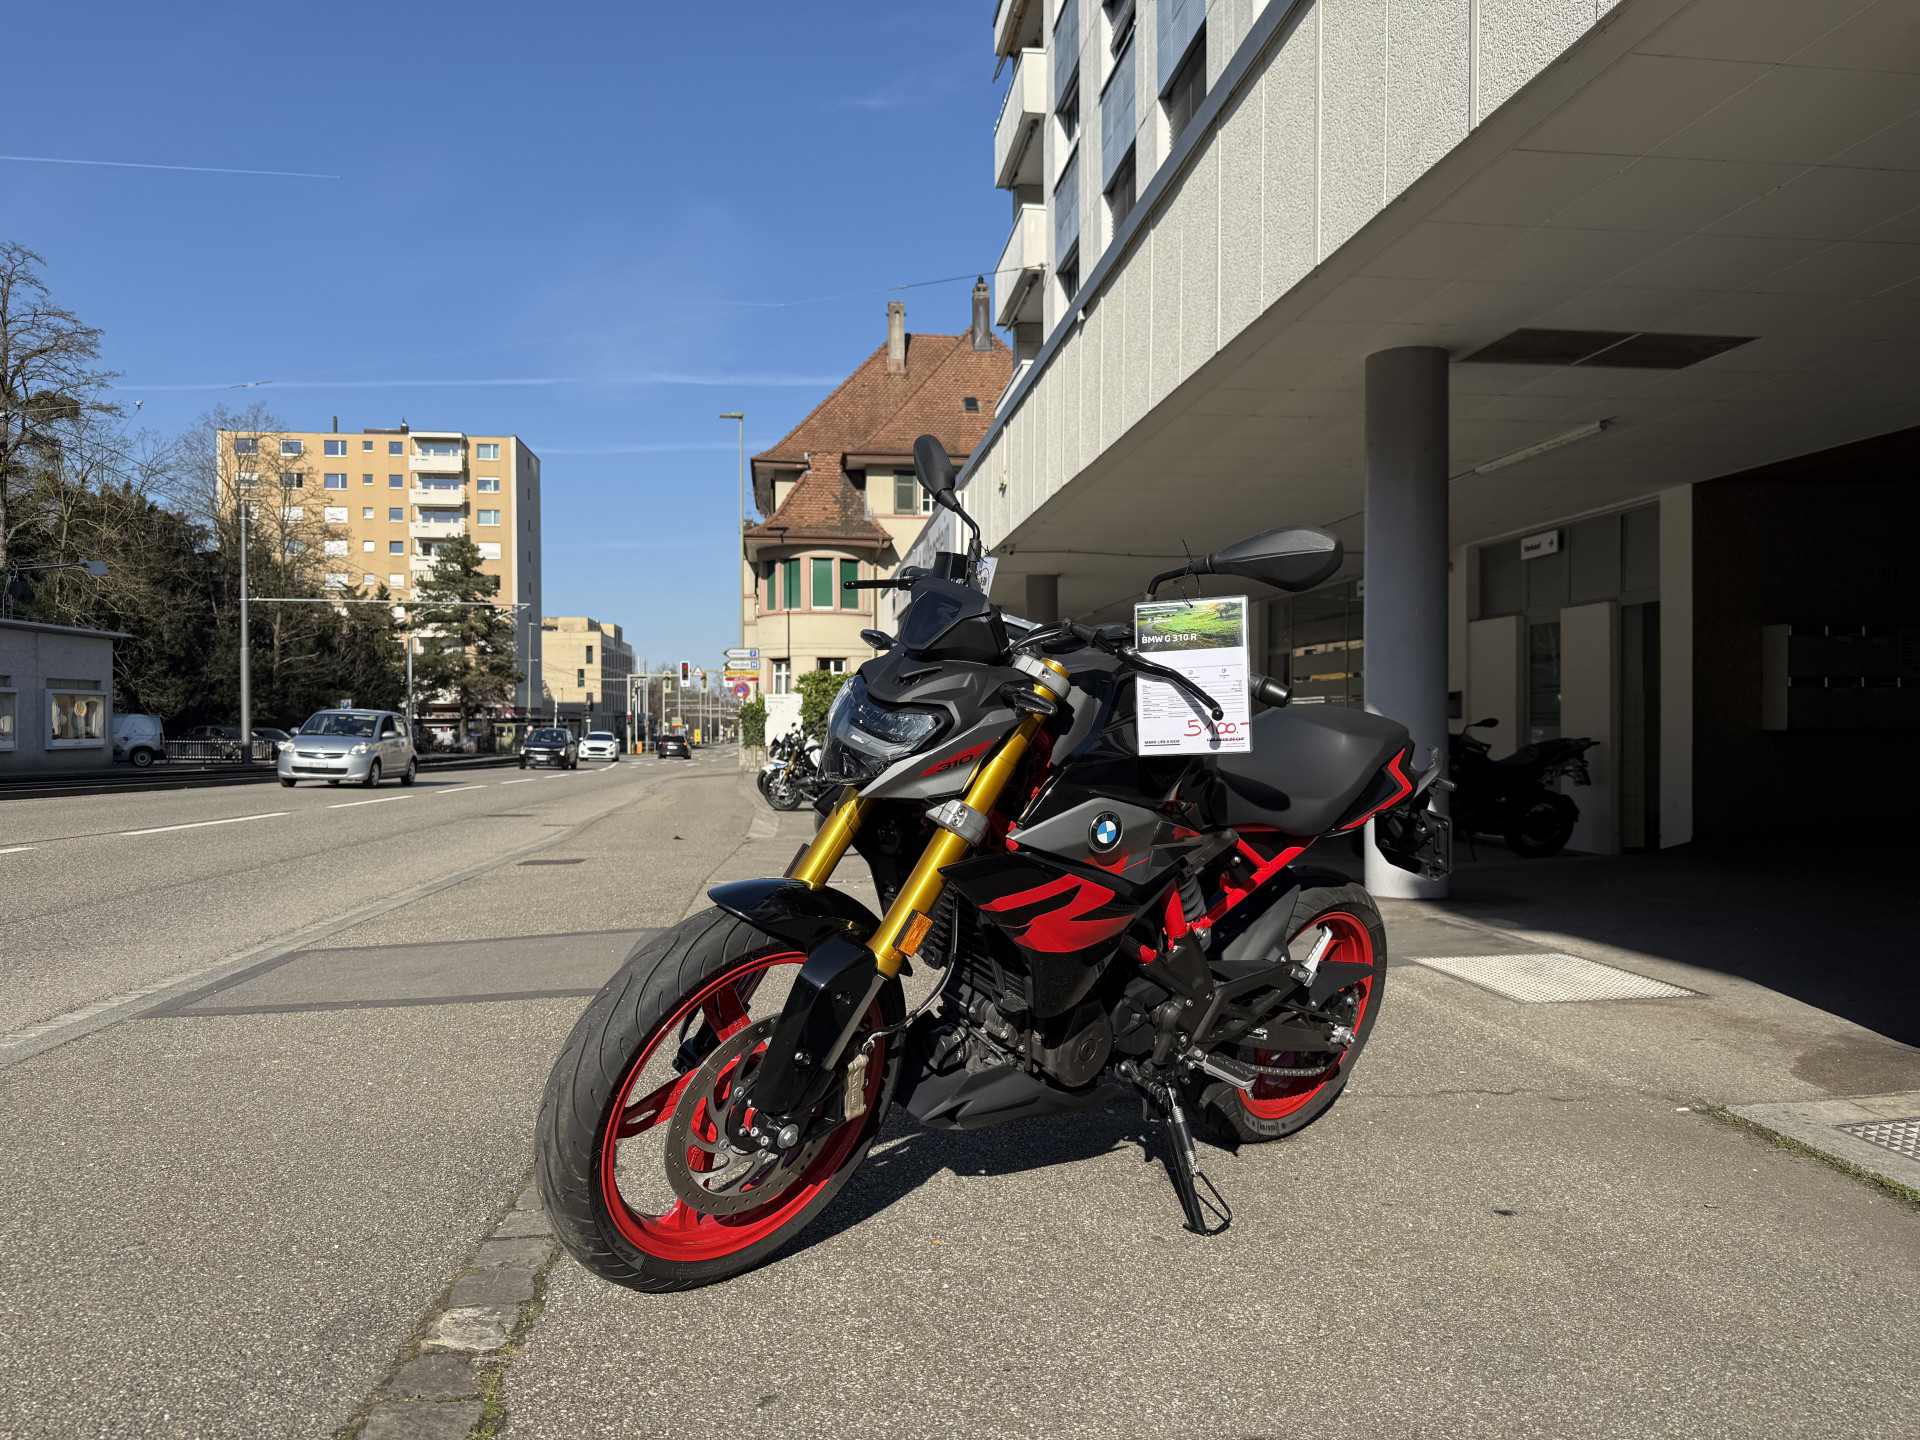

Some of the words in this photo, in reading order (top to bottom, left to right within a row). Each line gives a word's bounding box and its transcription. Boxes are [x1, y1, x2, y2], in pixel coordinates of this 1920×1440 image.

[1141, 634, 1163, 644] BMW
[1164, 634, 1171, 642] G
[1172, 633, 1189, 642] 310
[1190, 633, 1197, 641] R
[936, 753, 974, 772] 310
